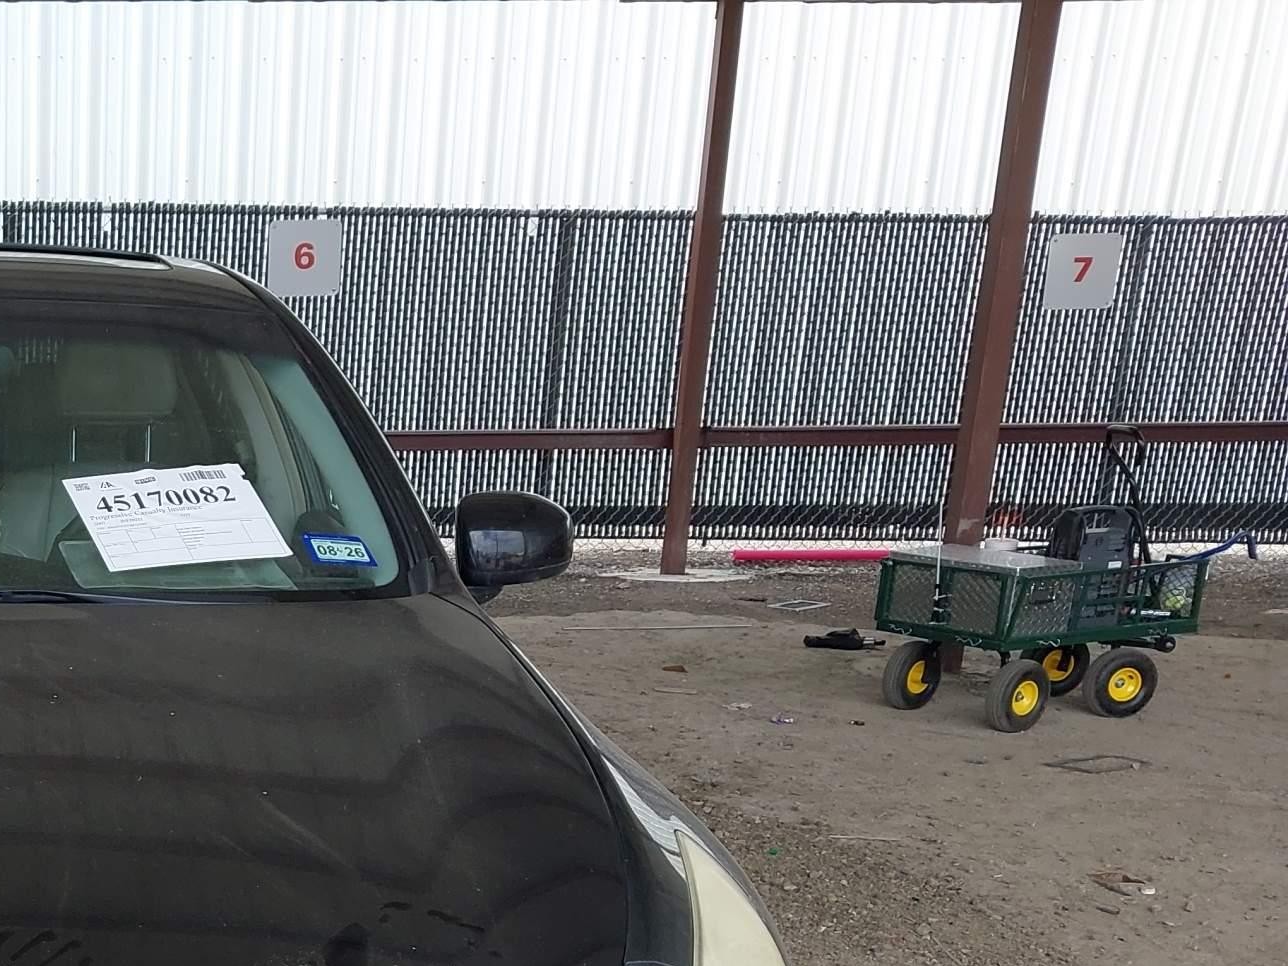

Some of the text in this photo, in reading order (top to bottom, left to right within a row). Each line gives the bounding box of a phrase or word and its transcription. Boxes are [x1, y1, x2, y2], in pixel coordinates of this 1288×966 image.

[294, 242, 315, 269] 6
[1073, 256, 1093, 283] 7
[96, 485, 236, 512] 45170082
[90, 511, 133, 521] Progressive
[134, 507, 166, 516] Casualty
[167, 505, 203, 513] Insurance
